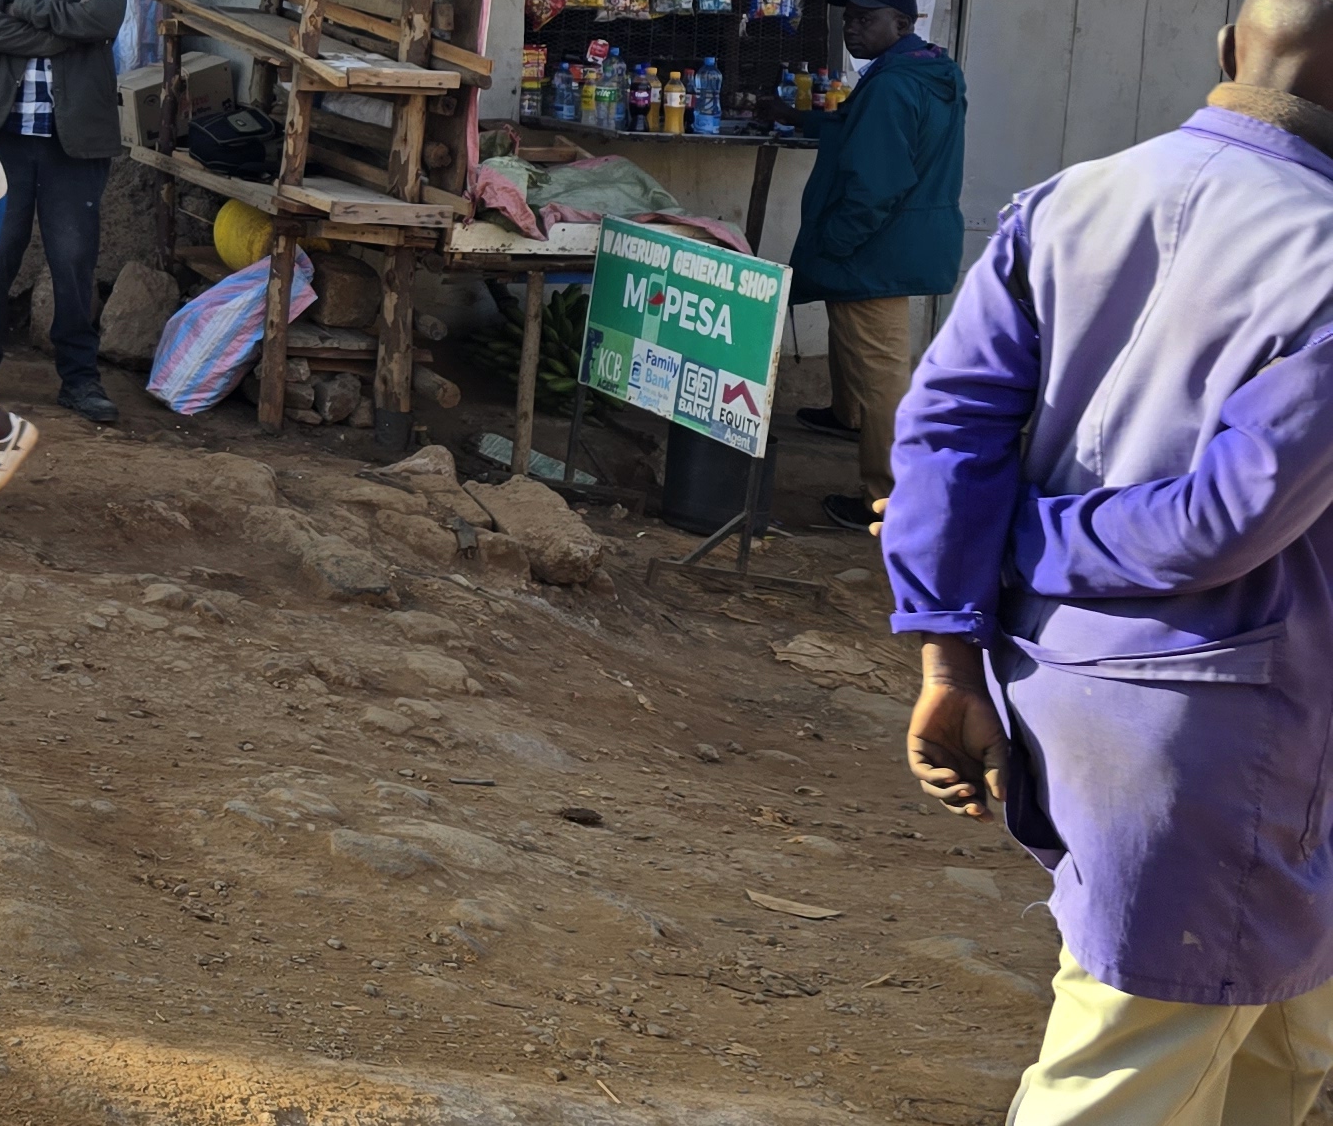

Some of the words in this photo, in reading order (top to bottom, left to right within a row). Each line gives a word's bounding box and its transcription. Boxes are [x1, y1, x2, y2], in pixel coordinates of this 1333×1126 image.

[602, 229, 671, 270] WAKERUBO
[673, 249, 735, 292] GENERAL
[737, 269, 778, 303] SHOP
[596, 347, 623, 382] KCB
[645, 348, 680, 377] Family
[596, 378, 620, 394] AGENT
[645, 368, 671, 392] Bank
[678, 398, 710, 422] BANK
[719, 407, 761, 440] EQUITY
[723, 427, 751, 451] Agent
